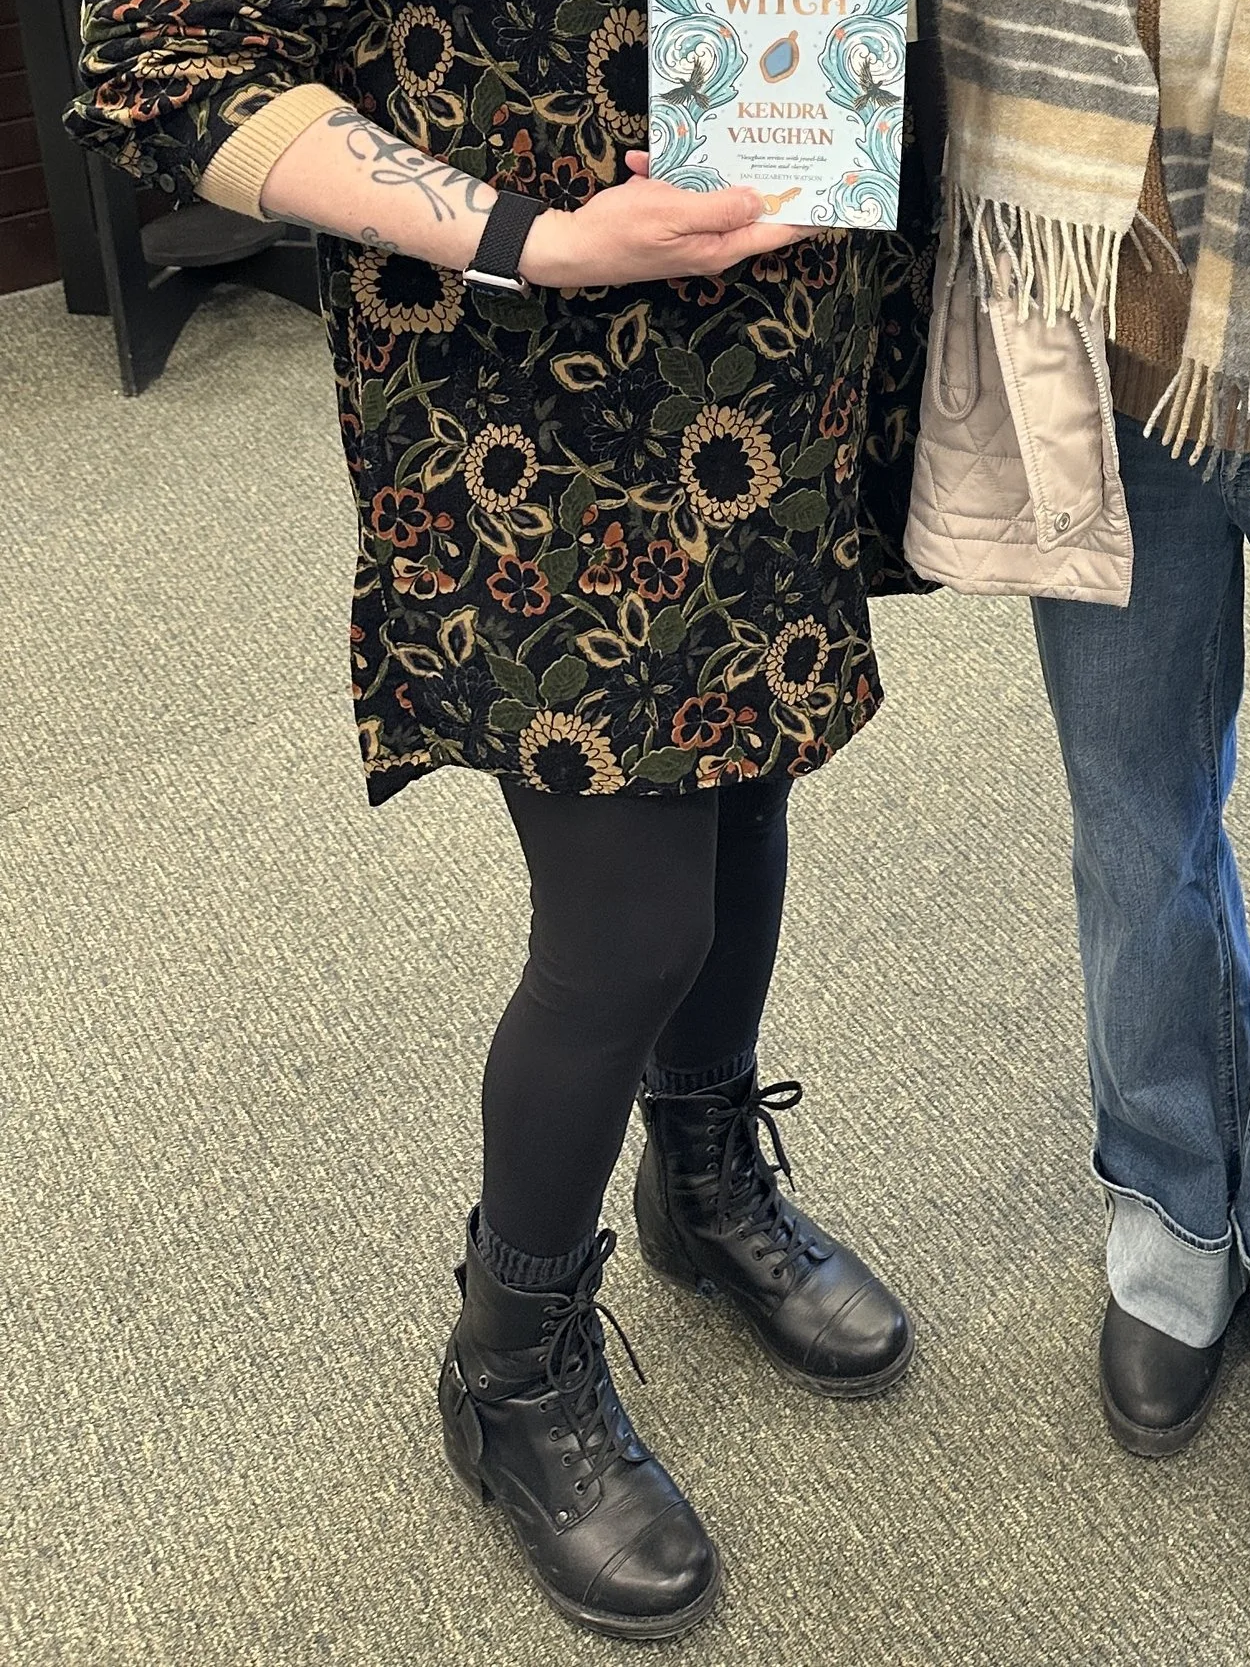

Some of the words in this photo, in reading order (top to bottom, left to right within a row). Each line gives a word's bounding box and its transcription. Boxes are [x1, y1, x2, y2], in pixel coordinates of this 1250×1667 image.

[736, 101, 829, 121] KENDRA
[727, 126, 834, 146] VAUGHAN
[754, 173, 793, 181] ELIZABETH
[793, 174, 823, 182] WATSON
